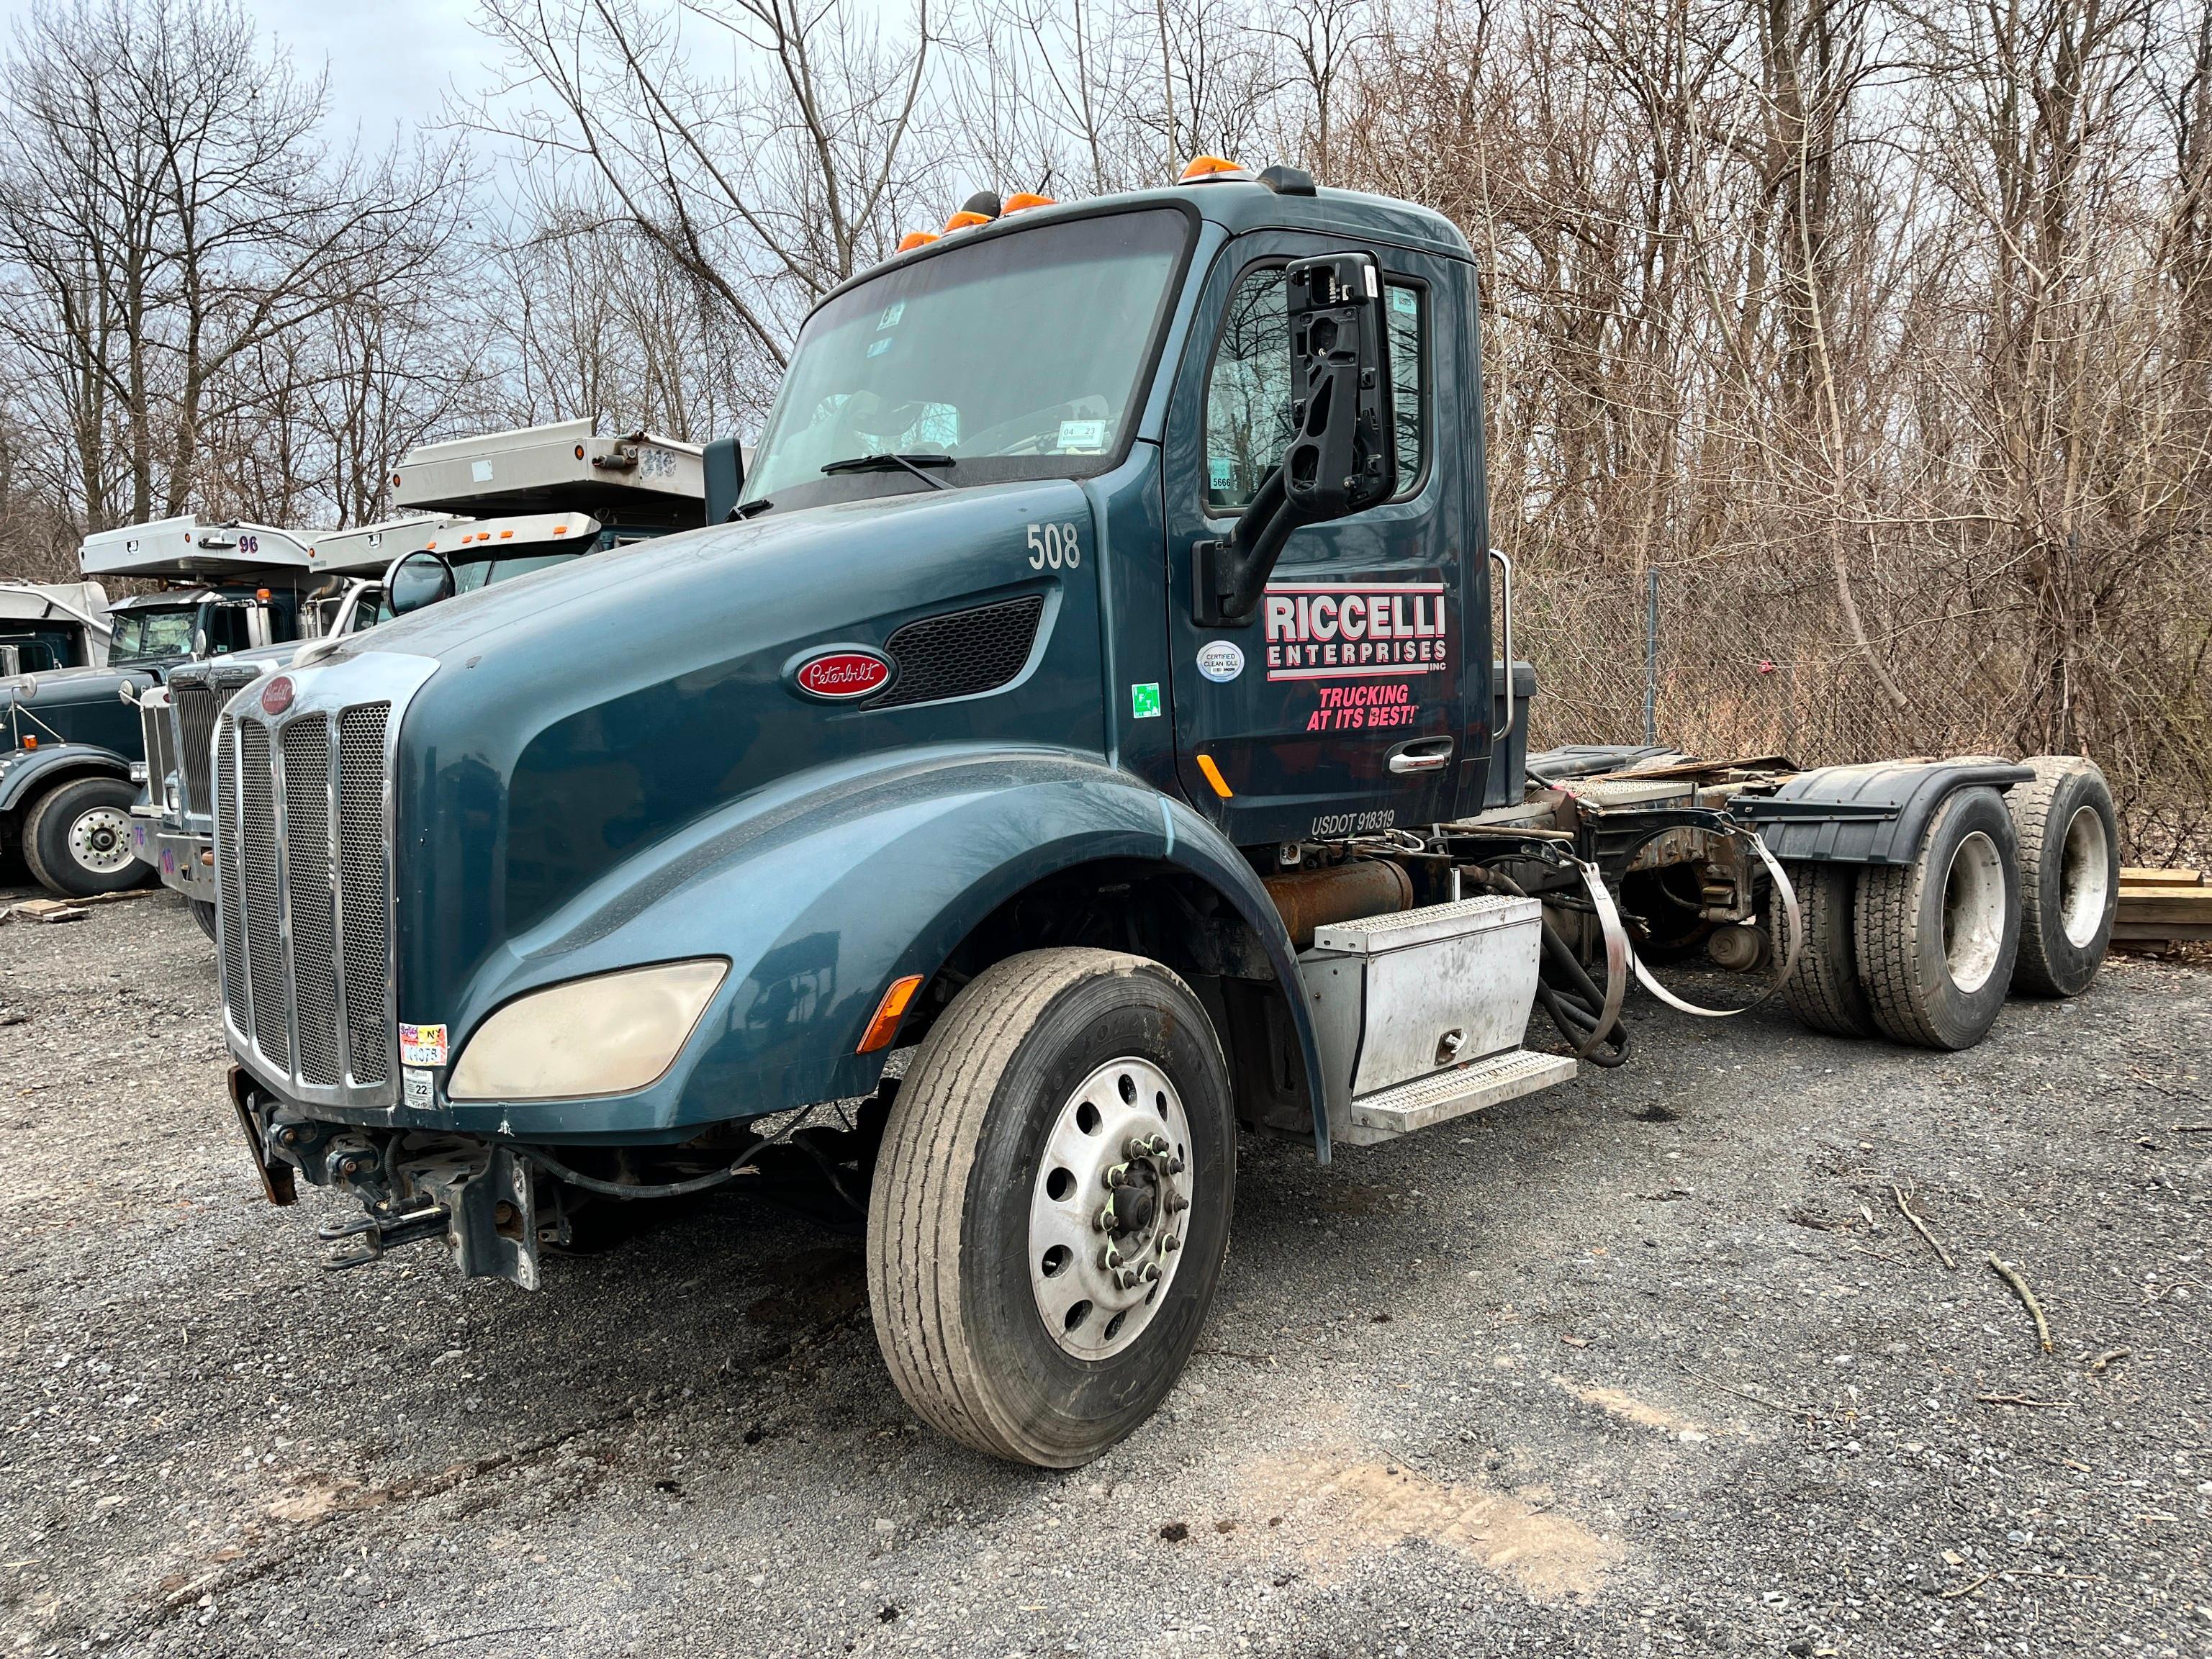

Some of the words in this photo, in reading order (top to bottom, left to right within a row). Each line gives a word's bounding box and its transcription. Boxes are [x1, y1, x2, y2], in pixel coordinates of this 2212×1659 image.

[1213, 478, 1231, 487] 5666
[239, 535, 258, 553] 96
[1027, 523, 1080, 570] 508
[1265, 595, 1445, 642] RICCELLI
[1268, 641, 1446, 666] ENTERPRISES
[810, 663, 880, 687] Peterbilt
[1320, 684, 1409, 708] TRUCKING
[1306, 710, 1332, 731] AT
[1335, 708, 1364, 728] ITS
[1368, 705, 1415, 726] BEST!
[1312, 813, 1357, 835] USDOT
[1358, 809, 1394, 831] 918319
[428, 1029, 441, 1039] NY
[415, 1085, 428, 1094] 22
